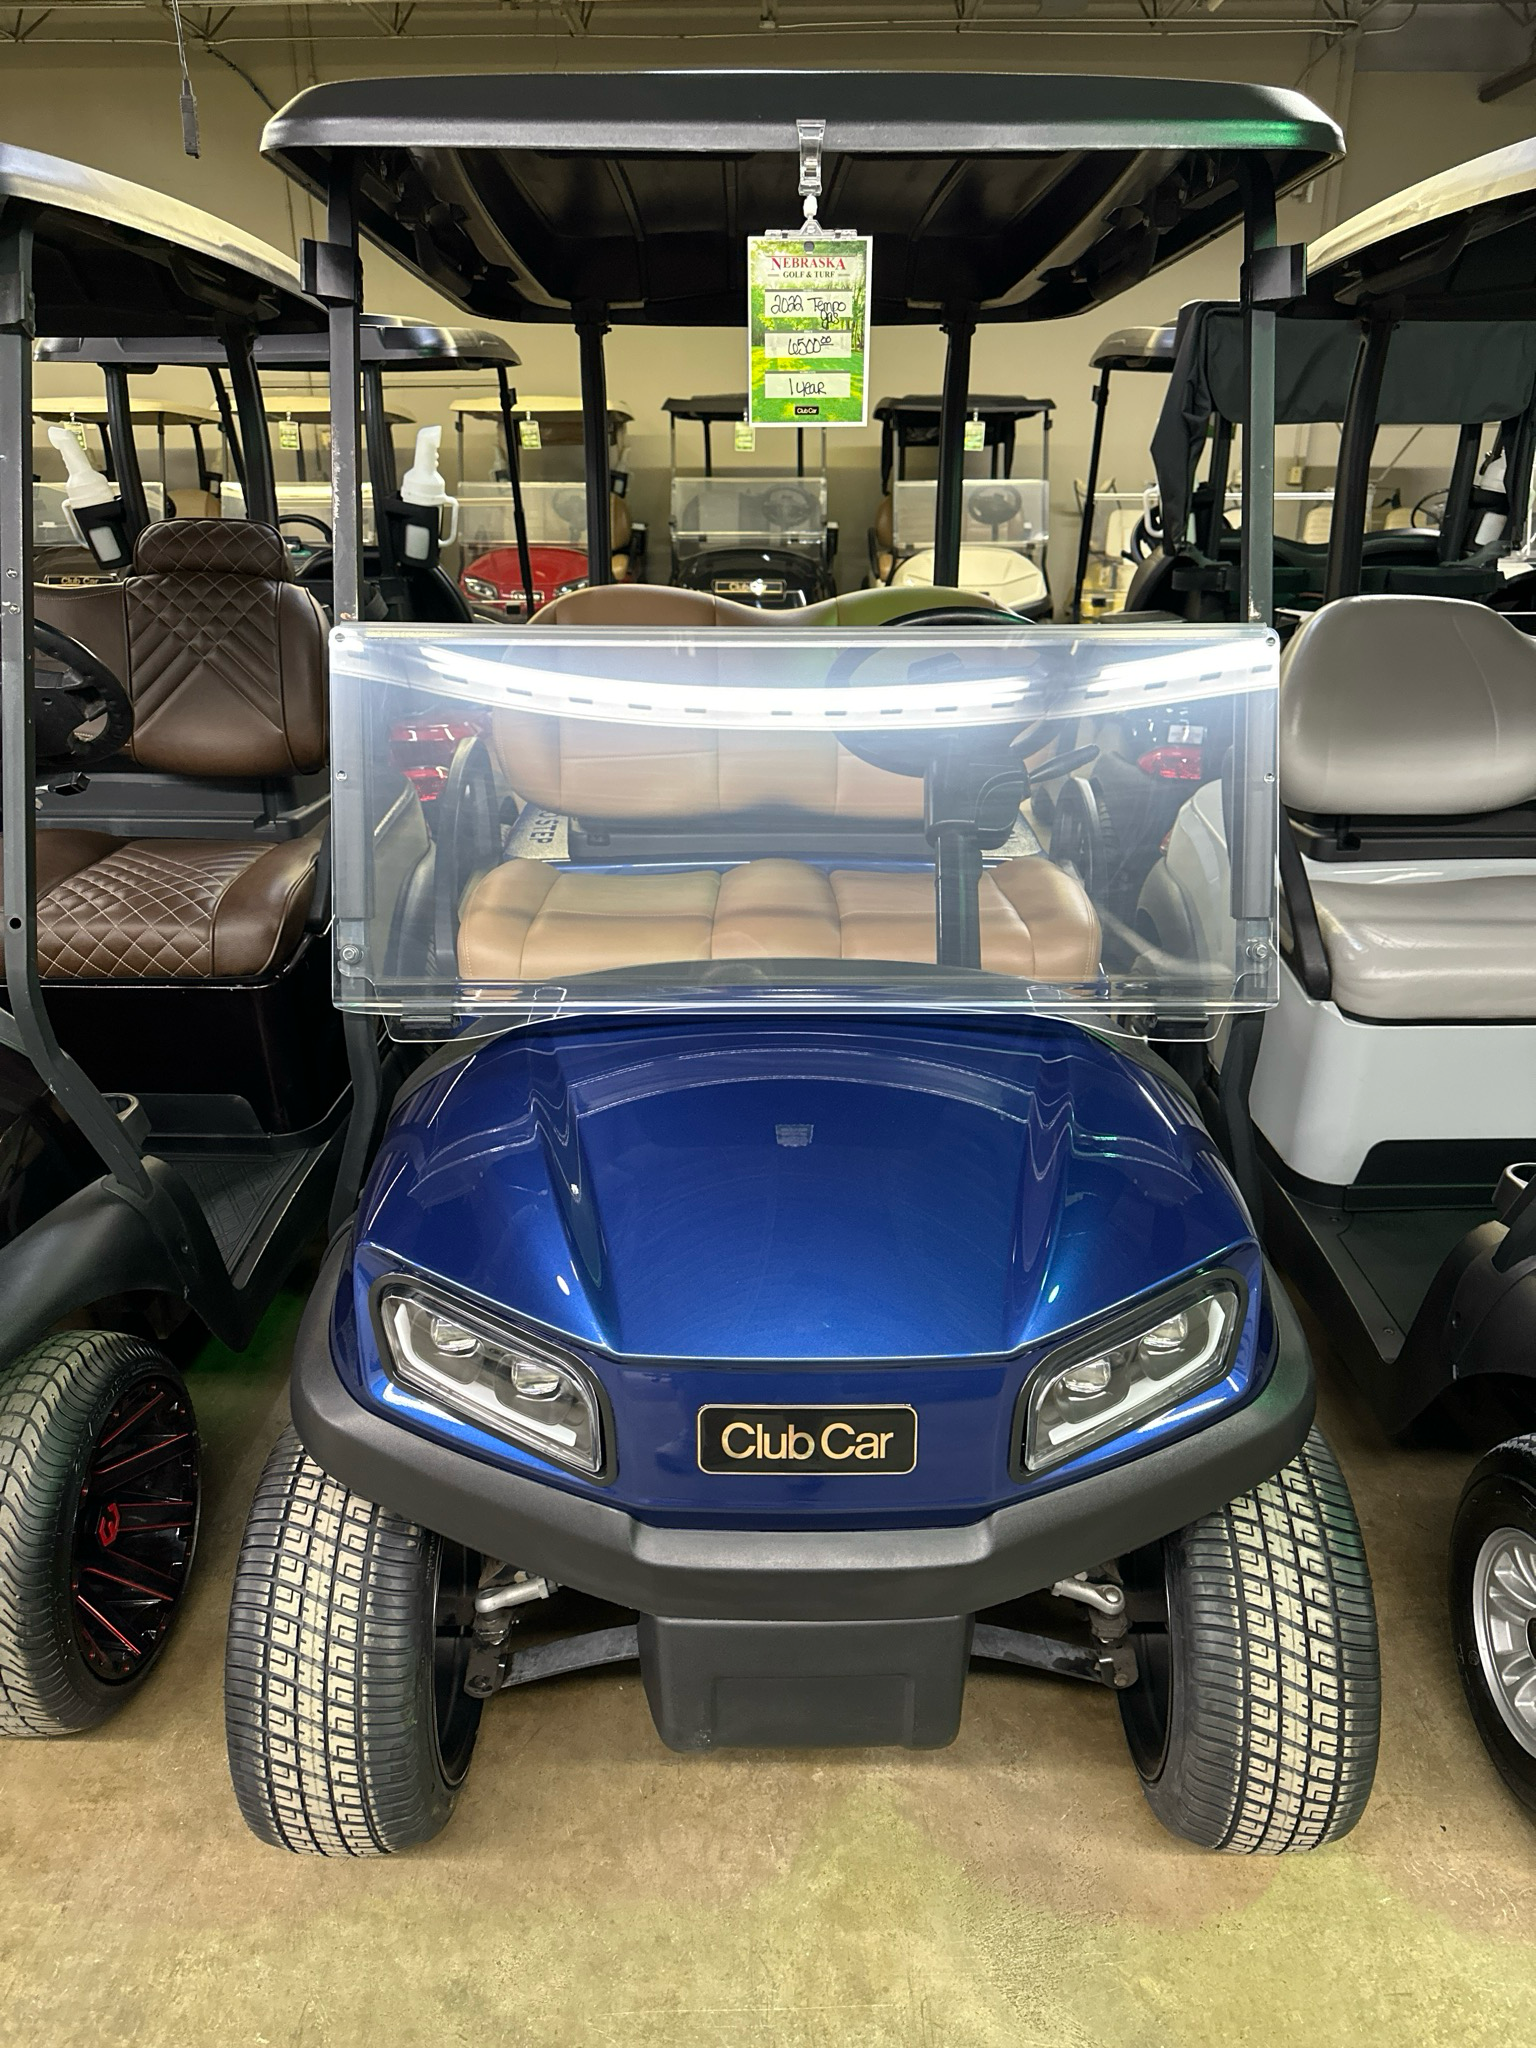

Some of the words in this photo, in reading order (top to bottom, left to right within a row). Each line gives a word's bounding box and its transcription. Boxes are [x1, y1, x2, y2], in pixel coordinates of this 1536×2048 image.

[771, 257, 846, 270] NEBRASKA
[771, 294, 804, 314] 2022
[807, 297, 846, 315] Tempo
[529, 819, 559, 844] STEP
[721, 1422, 815, 1460] Club
[821, 1422, 894, 1460] Car
